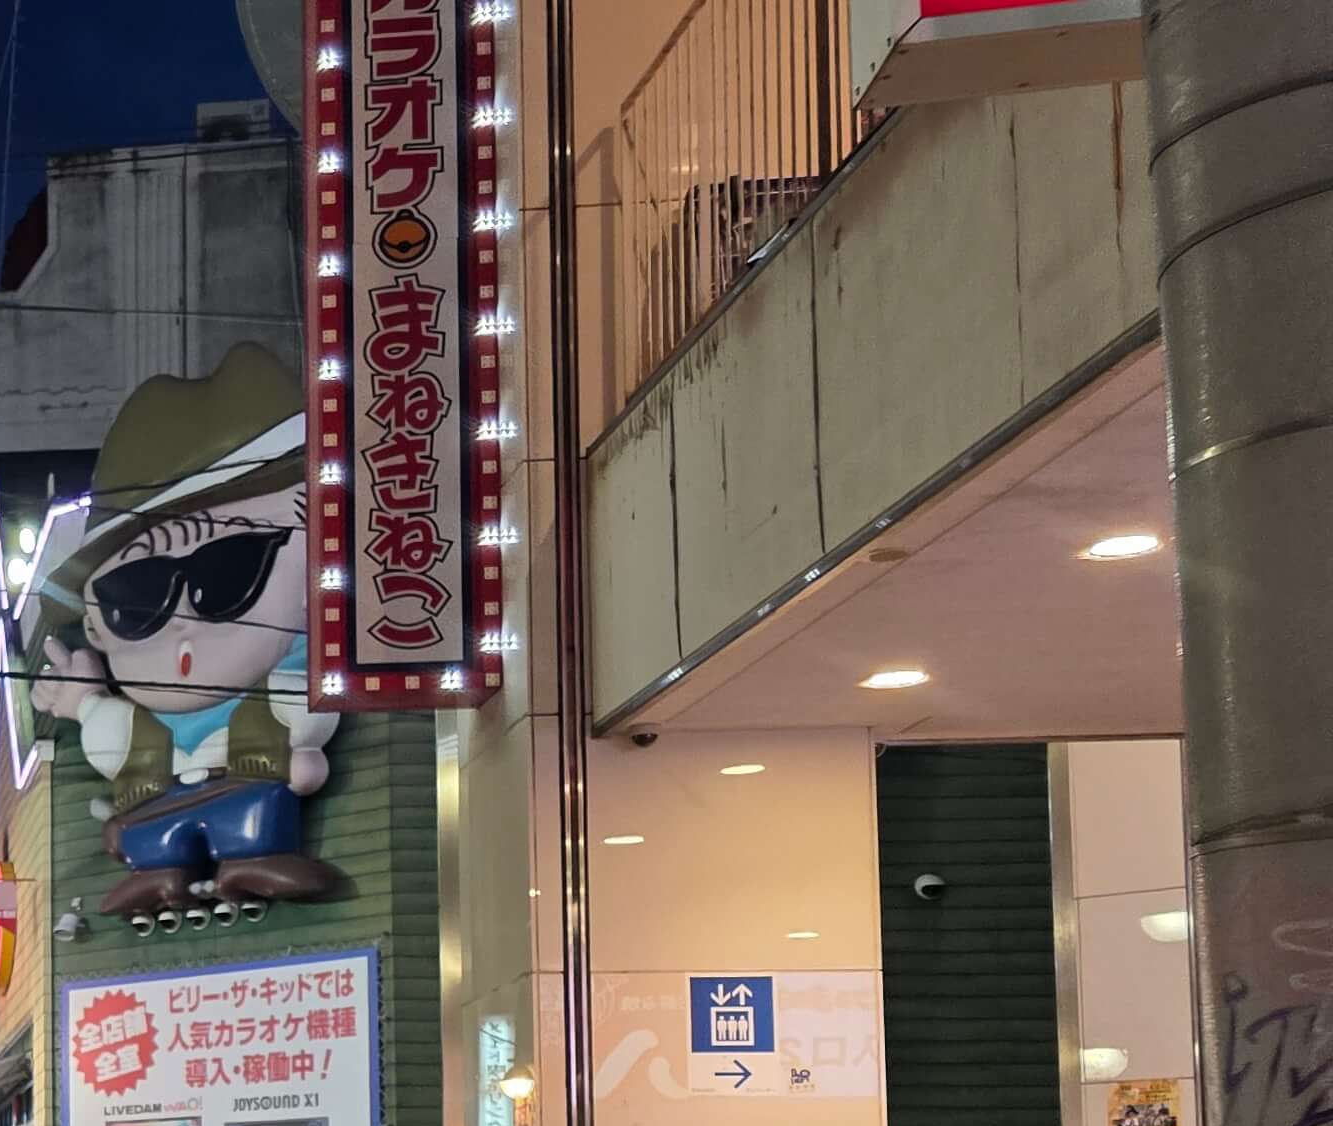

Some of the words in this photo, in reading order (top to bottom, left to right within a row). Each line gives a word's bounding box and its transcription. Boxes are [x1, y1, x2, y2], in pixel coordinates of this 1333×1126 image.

[364, 276, 450, 650] まねきねこ
[168, 968, 355, 1014] ビリー・ザ・キッドでは
[167, 1006, 357, 1053] 人気カラオケ機種
[104, 1102, 163, 1116] LIVEDAM
[233, 1094, 300, 1113] JOYSOUND
